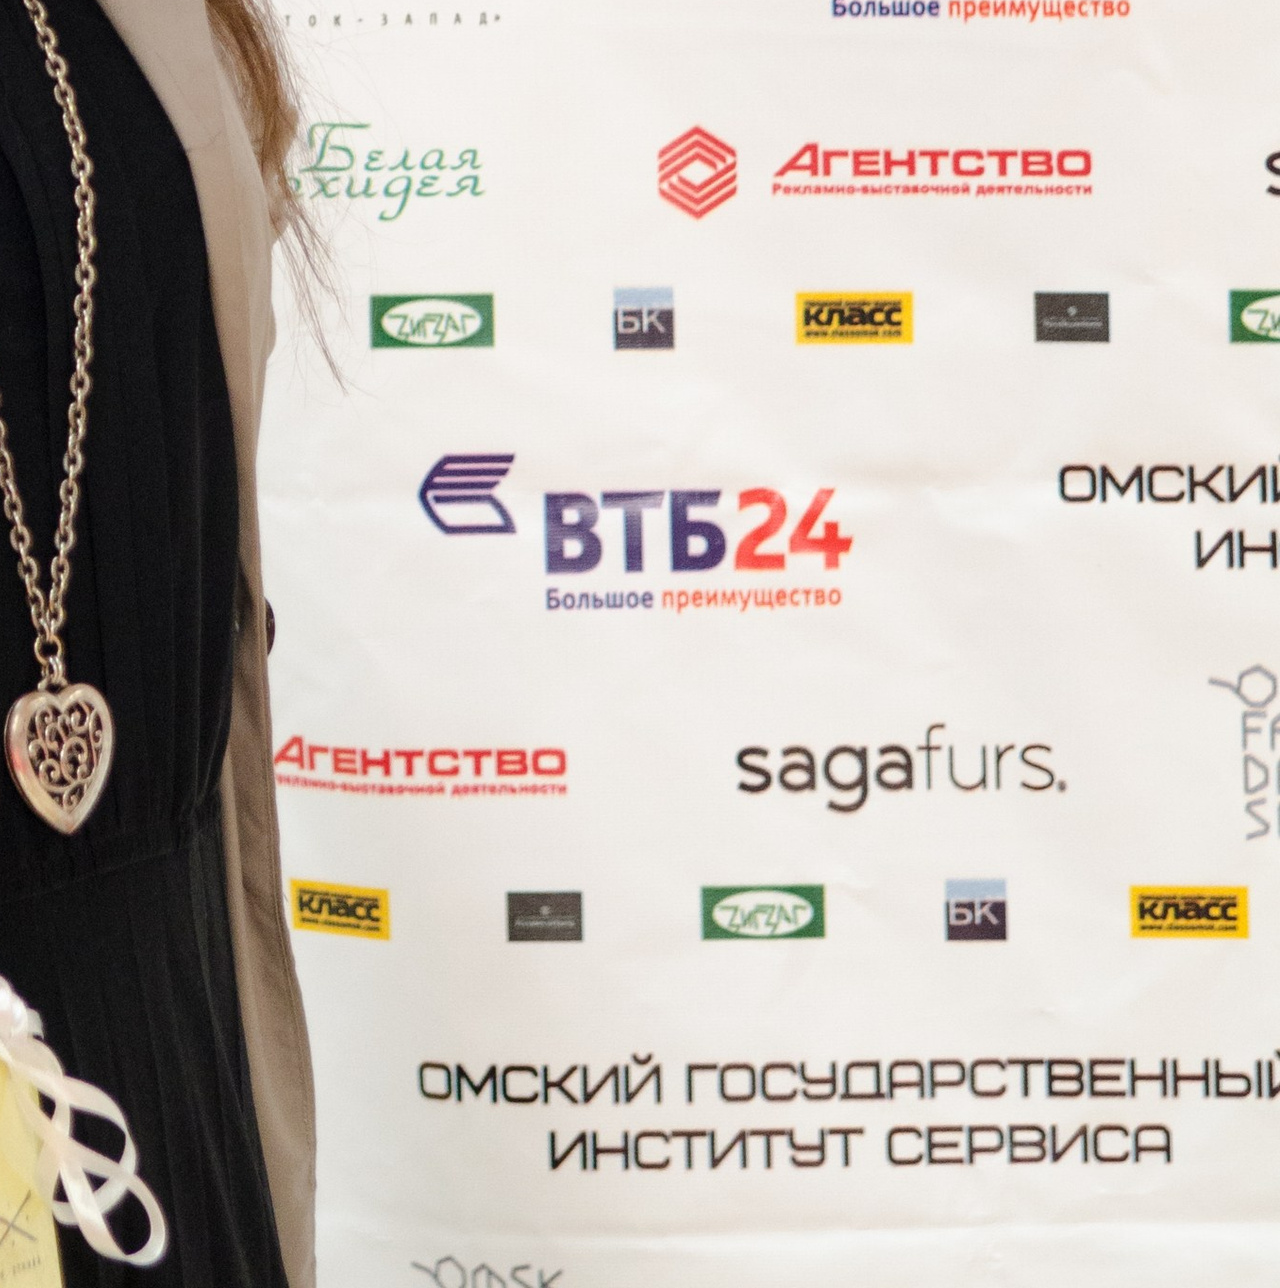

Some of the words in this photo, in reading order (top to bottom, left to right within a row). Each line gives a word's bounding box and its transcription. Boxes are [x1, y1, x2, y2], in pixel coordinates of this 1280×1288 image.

[617, 307, 665, 334] БК
[543, 486, 855, 575] ВТБ24
[546, 587, 654, 611] Большое
[662, 588, 842, 614] преимущество
[949, 898, 998, 925] БК
[417, 1052, 663, 1107] ОМСКИЙ
[548, 1126, 866, 1172] ИНСТИТУТ
[885, 1123, 1173, 1167] СЕРВИСА
